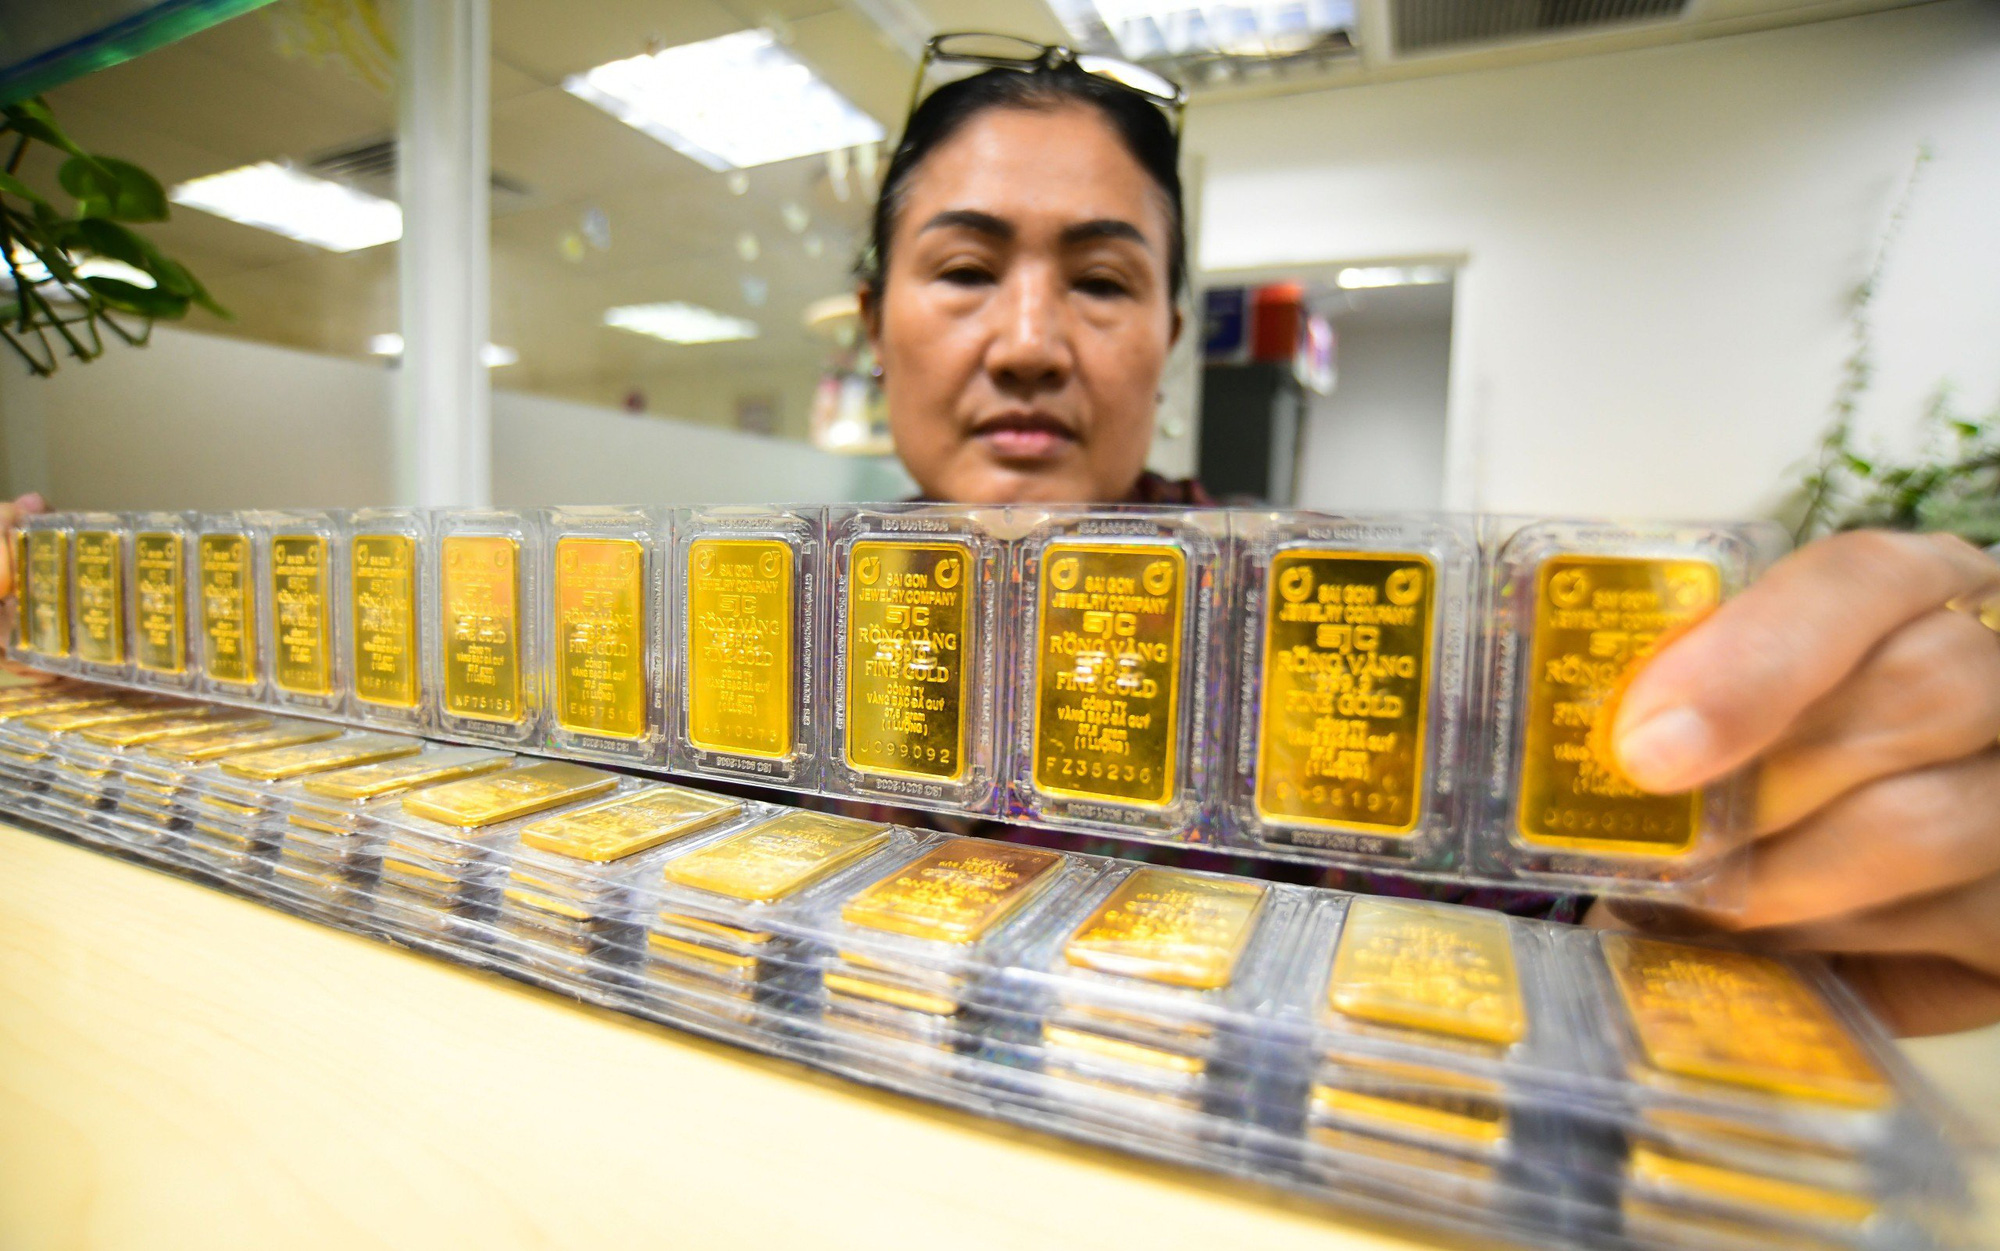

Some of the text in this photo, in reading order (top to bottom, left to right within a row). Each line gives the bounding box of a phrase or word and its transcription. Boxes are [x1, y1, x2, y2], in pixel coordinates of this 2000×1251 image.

[886, 573, 928, 588] SAI GON
[1084, 575, 1136, 594] SAI GON
[719, 594, 757, 618] SJC
[859, 588, 957, 606] JEWELRY COMPANY
[1051, 591, 1169, 614] JEWELRY COMPANY
[886, 605, 930, 629] SJC
[1083, 610, 1137, 639] SJC
[597, 641, 629, 657] GOLD
[1316, 623, 1380, 655] SJC
[736, 650, 774, 667] GOLD
[865, 660, 950, 683] FINE GOLD
[887, 682, 925, 698] CÔNG TY
[1056, 671, 1157, 698] FINE GOLD
[867, 691, 890, 706] VÀNG
[925, 698, 945, 711] QUÝ
[1338, 693, 1403, 718] GOLD
[861, 740, 950, 763] JC99092
[1046, 756, 1152, 784] FZ35236
[924, 785, 943, 797] ISO
